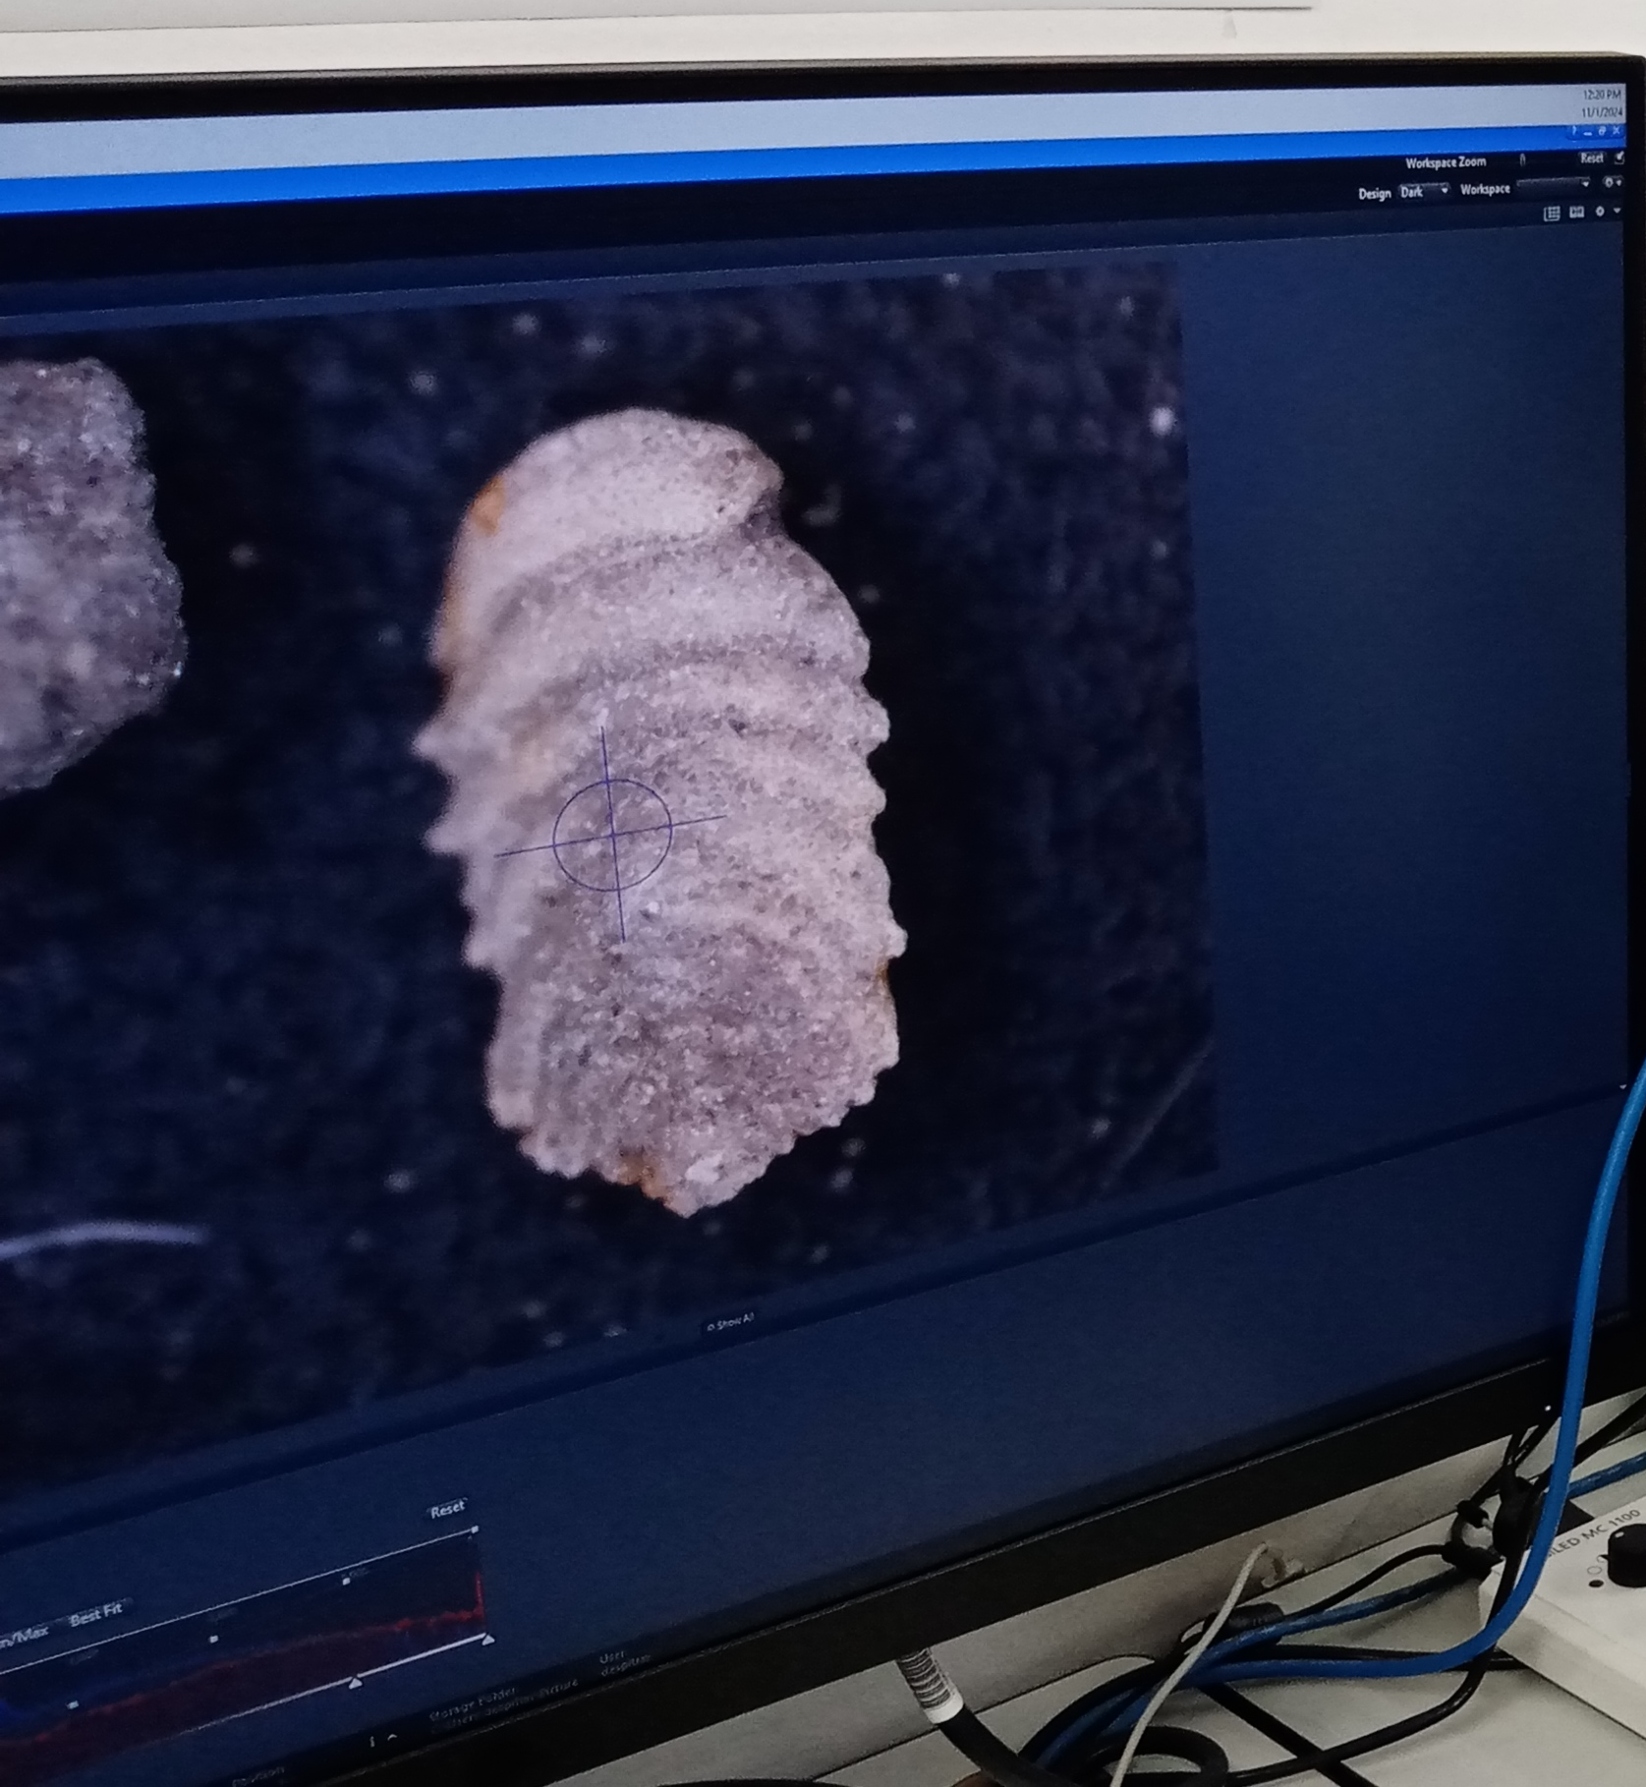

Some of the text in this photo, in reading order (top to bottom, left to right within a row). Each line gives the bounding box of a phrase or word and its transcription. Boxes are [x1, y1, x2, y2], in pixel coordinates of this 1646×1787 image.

[1607, 89, 1622, 100] PM
[1406, 152, 1604, 172] Workspace Zoom Reset
[1358, 182, 1511, 202] Design Dark Workspace
[430, 1500, 466, 1520] Reset
[1581, 1524, 1608, 1540] MC
[1608, 1509, 1641, 1527] 1100
[70, 1610, 101, 1628] Best
[103, 1603, 123, 1618] Fit
